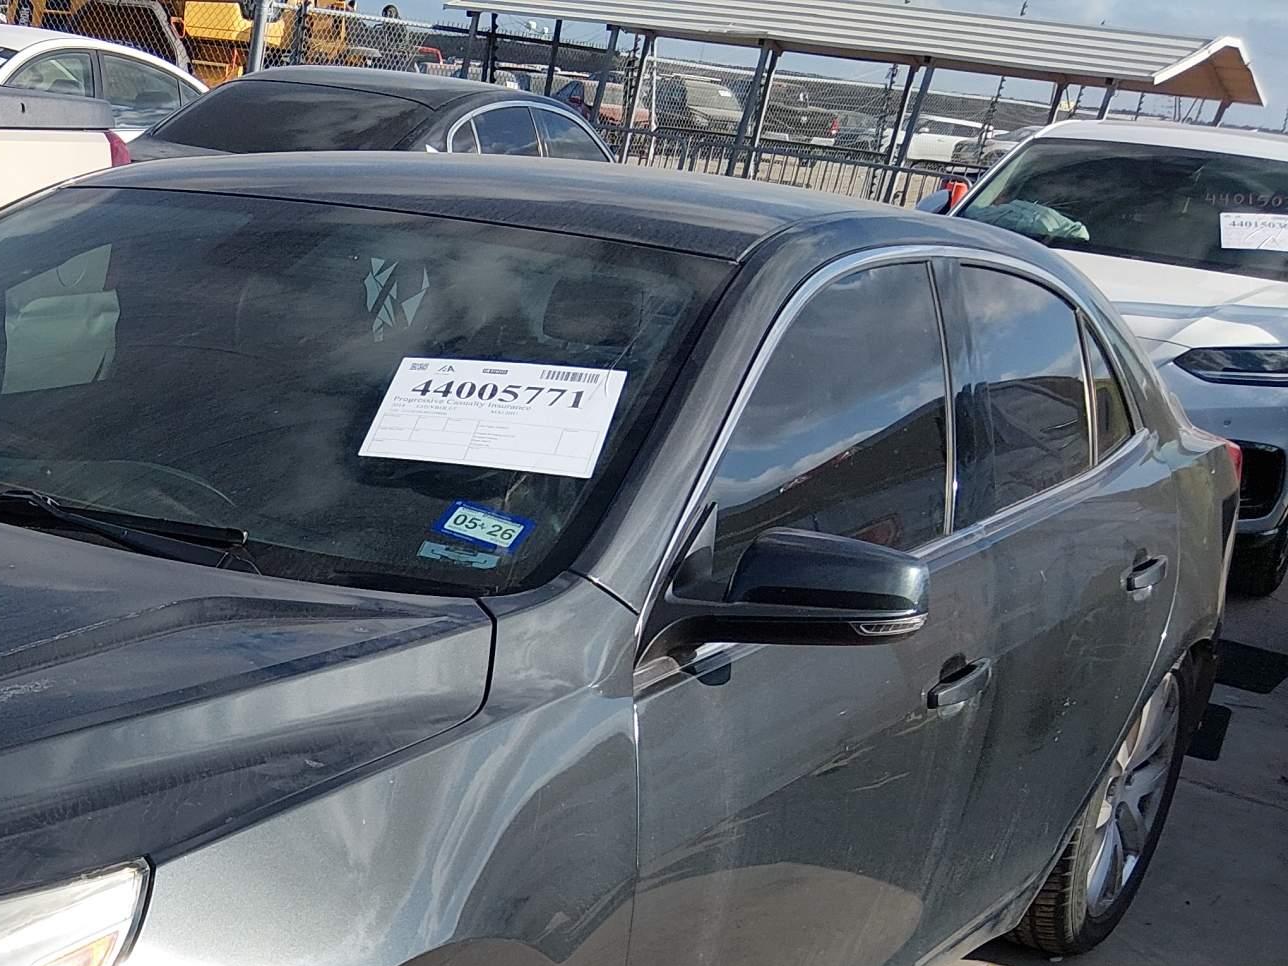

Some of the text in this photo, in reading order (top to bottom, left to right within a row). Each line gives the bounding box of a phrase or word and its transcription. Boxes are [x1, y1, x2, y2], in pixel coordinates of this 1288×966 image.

[392, 395, 532, 411] Progressive Casualty Insurance
[411, 379, 586, 409] 44005771
[452, 513, 482, 530] 05
[485, 523, 517, 541] 26
